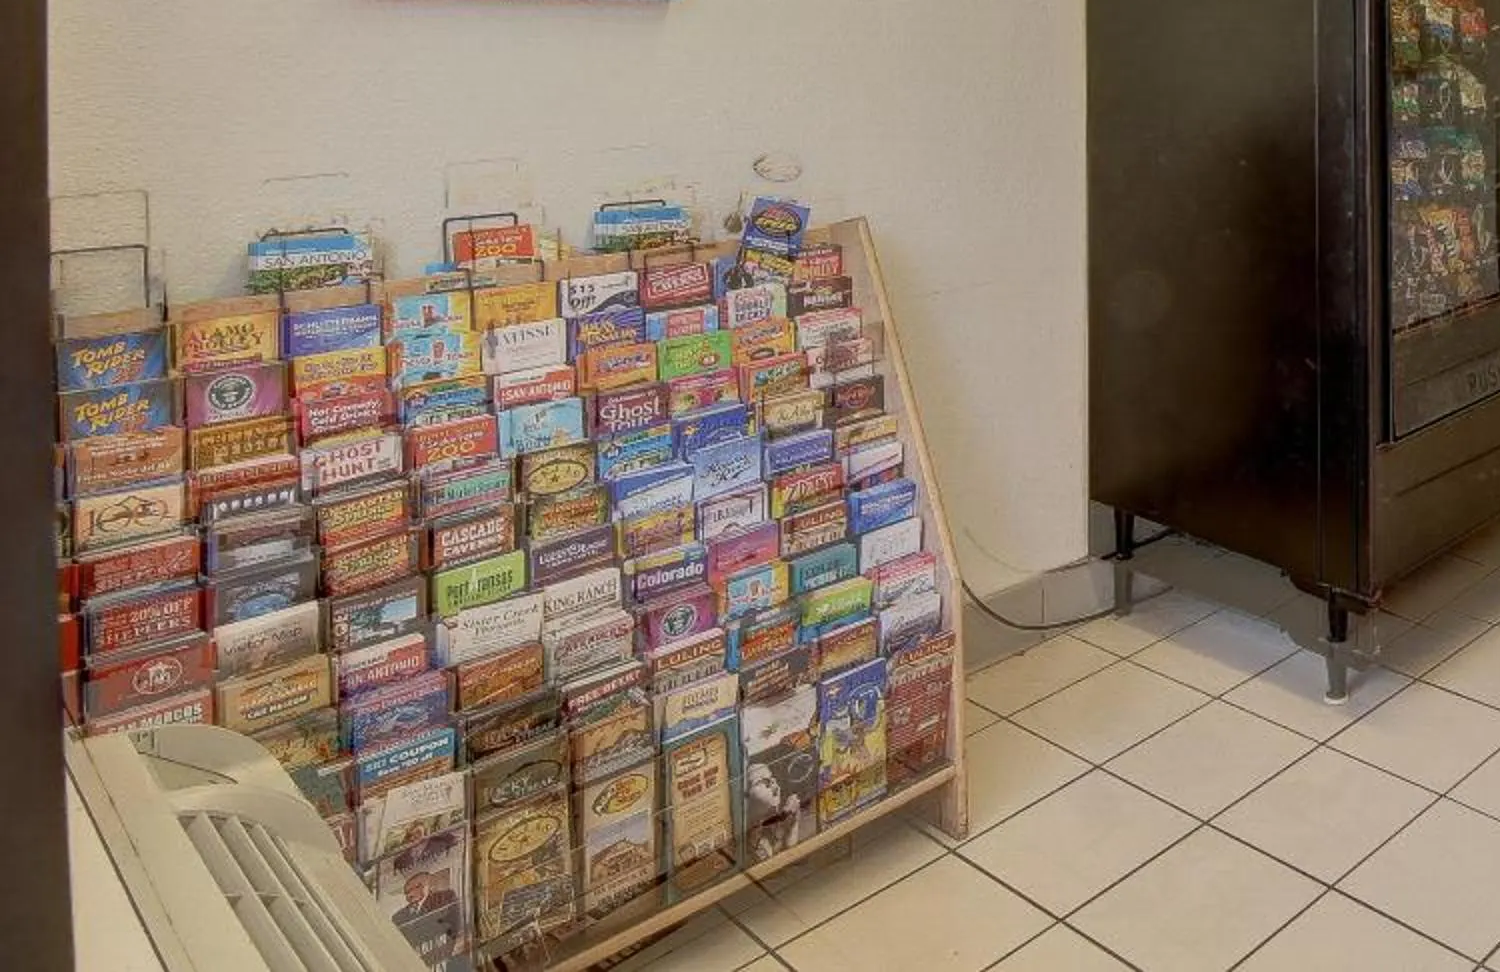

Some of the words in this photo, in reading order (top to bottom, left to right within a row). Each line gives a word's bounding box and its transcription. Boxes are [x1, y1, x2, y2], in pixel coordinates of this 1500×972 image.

[265, 256, 295, 269] SAN
[299, 249, 367, 265] ANTONIO
[185, 323, 255, 345] ALAMO
[71, 341, 126, 368] TOMB
[85, 348, 146, 378] RIDER
[505, 386, 528, 401] SAN
[74, 393, 129, 423] TOMB
[90, 399, 151, 431] RIDER
[600, 399, 662, 427] Ghost
[605, 415, 653, 433] Tour
[313, 440, 385, 467] GHOST
[427, 440, 476, 463] ZOO
[322, 458, 374, 481] HUNT
[441, 517, 506, 545] CASCADE
[636, 561, 705, 587] Colorado
[544, 593, 575, 613] KING
[577, 578, 616, 603] RANCH
[129, 605, 161, 623] 20%
[163, 597, 194, 614] OFF
[272, 627, 304, 643] Map
[656, 640, 724, 669] LULING
[367, 655, 421, 681] ANTONIO
[140, 702, 203, 727] MARCOS
[389, 737, 450, 762] COUPON
